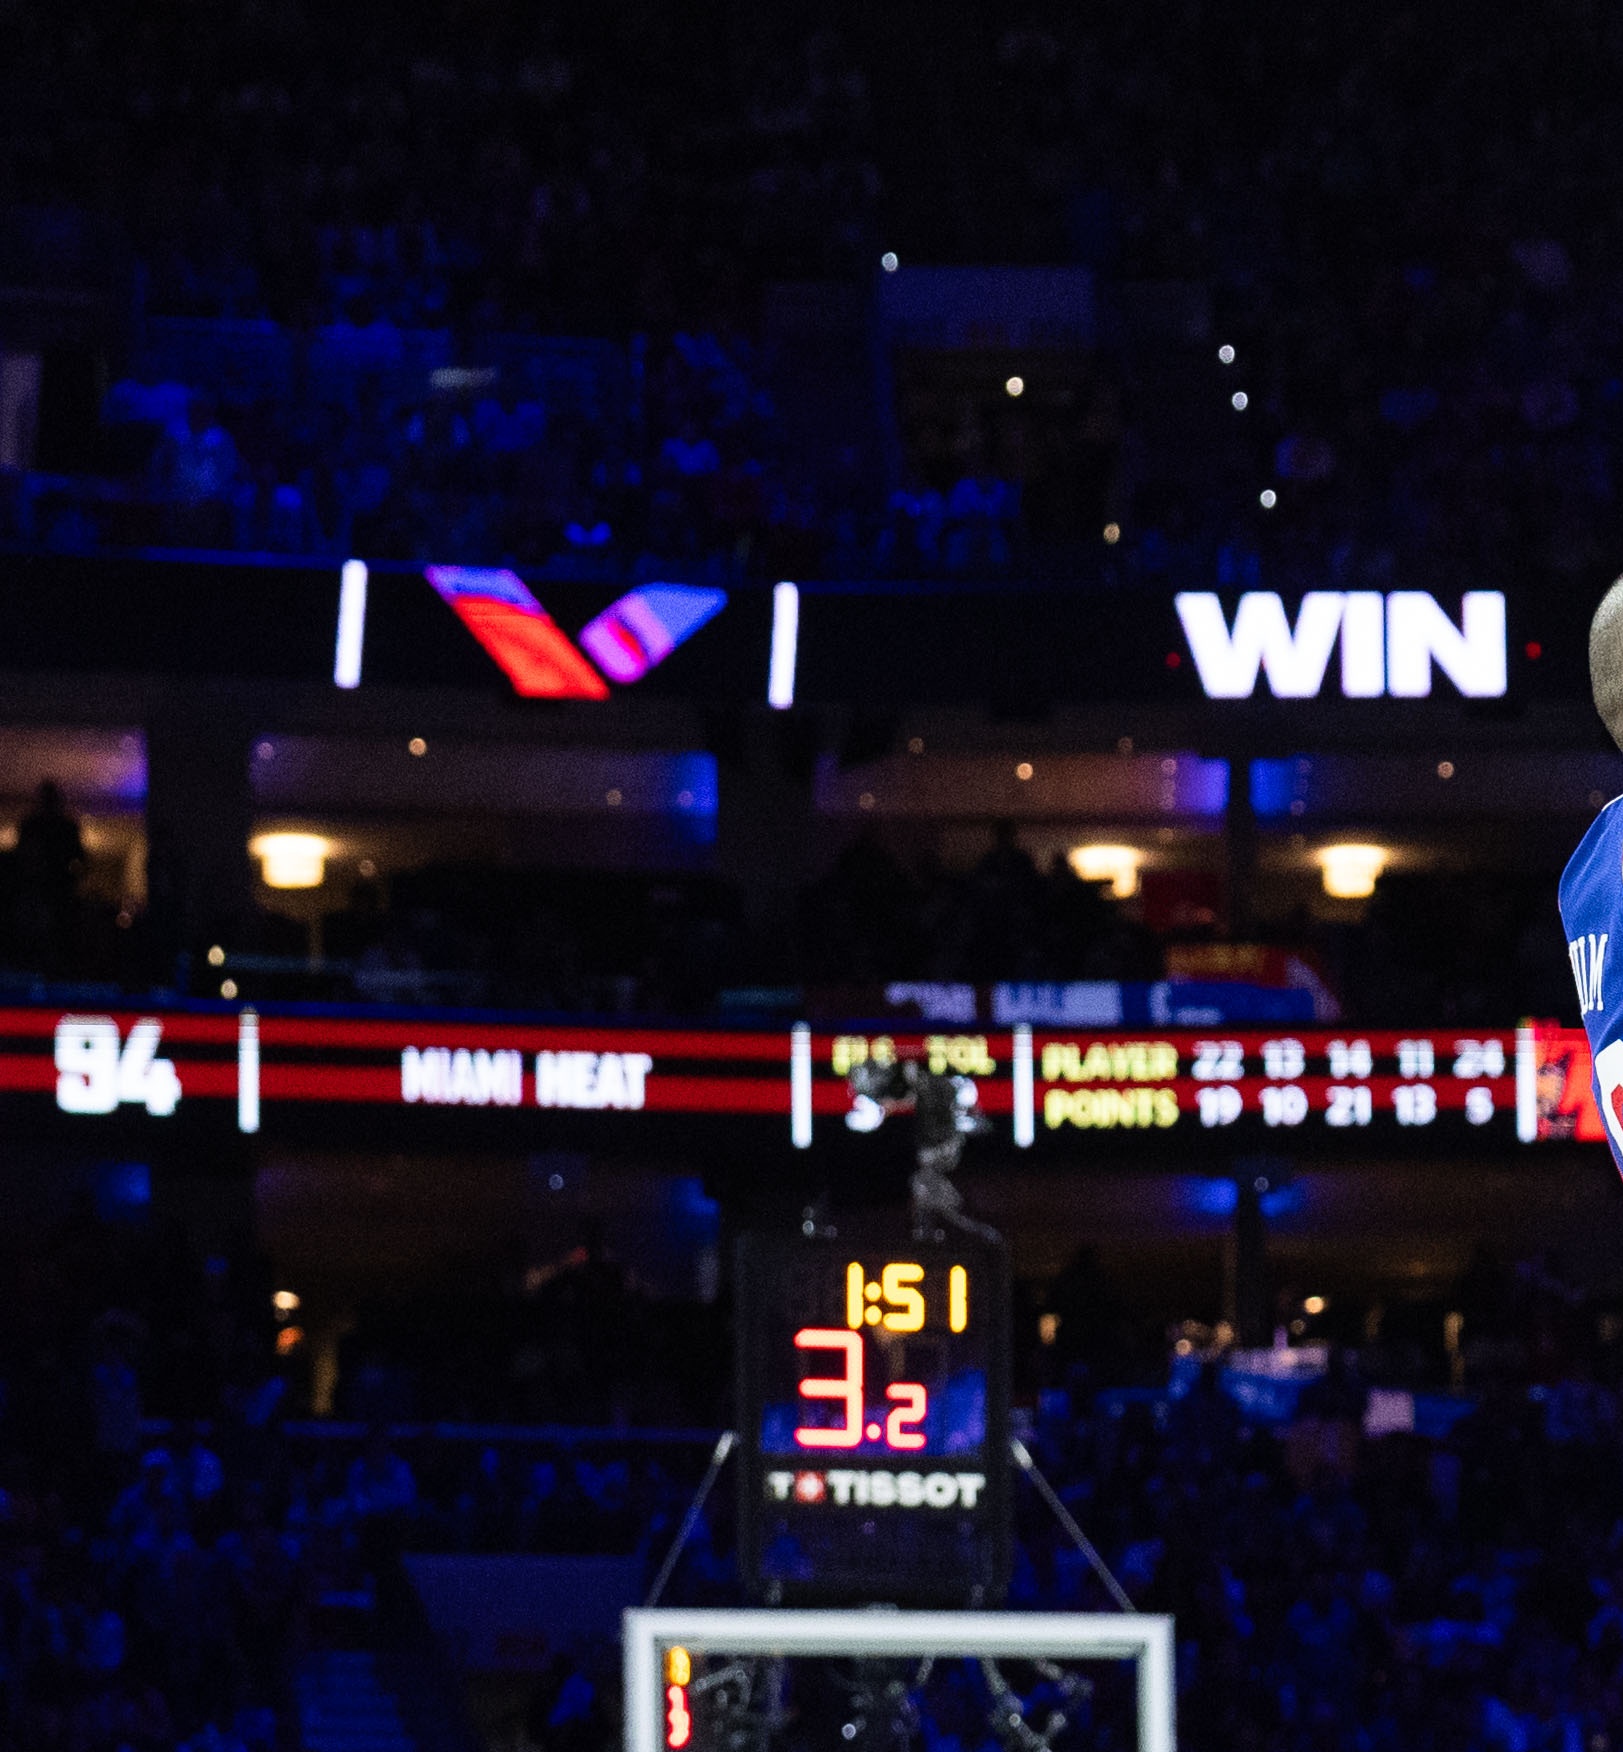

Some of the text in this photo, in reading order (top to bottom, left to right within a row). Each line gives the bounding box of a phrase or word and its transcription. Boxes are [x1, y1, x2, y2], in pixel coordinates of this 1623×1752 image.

[1175, 591, 1506, 698] WIN
[54, 1013, 181, 1116] 94
[401, 1045, 652, 1110] MIAMI HEAT
[1042, 1041, 1178, 1082] PLAYER
[1191, 1040, 1244, 1081] 22
[1326, 1039, 1373, 1079] 14
[1394, 1039, 1435, 1079] 11
[1453, 1039, 1505, 1079] 24
[1044, 1087, 1180, 1130] POINTS
[1258, 1084, 1308, 1127] 10
[846, 1261, 967, 1334] 1:51
[795, 1328, 927, 1449] 3.2
[832, 1470, 985, 1508] TISSOT
